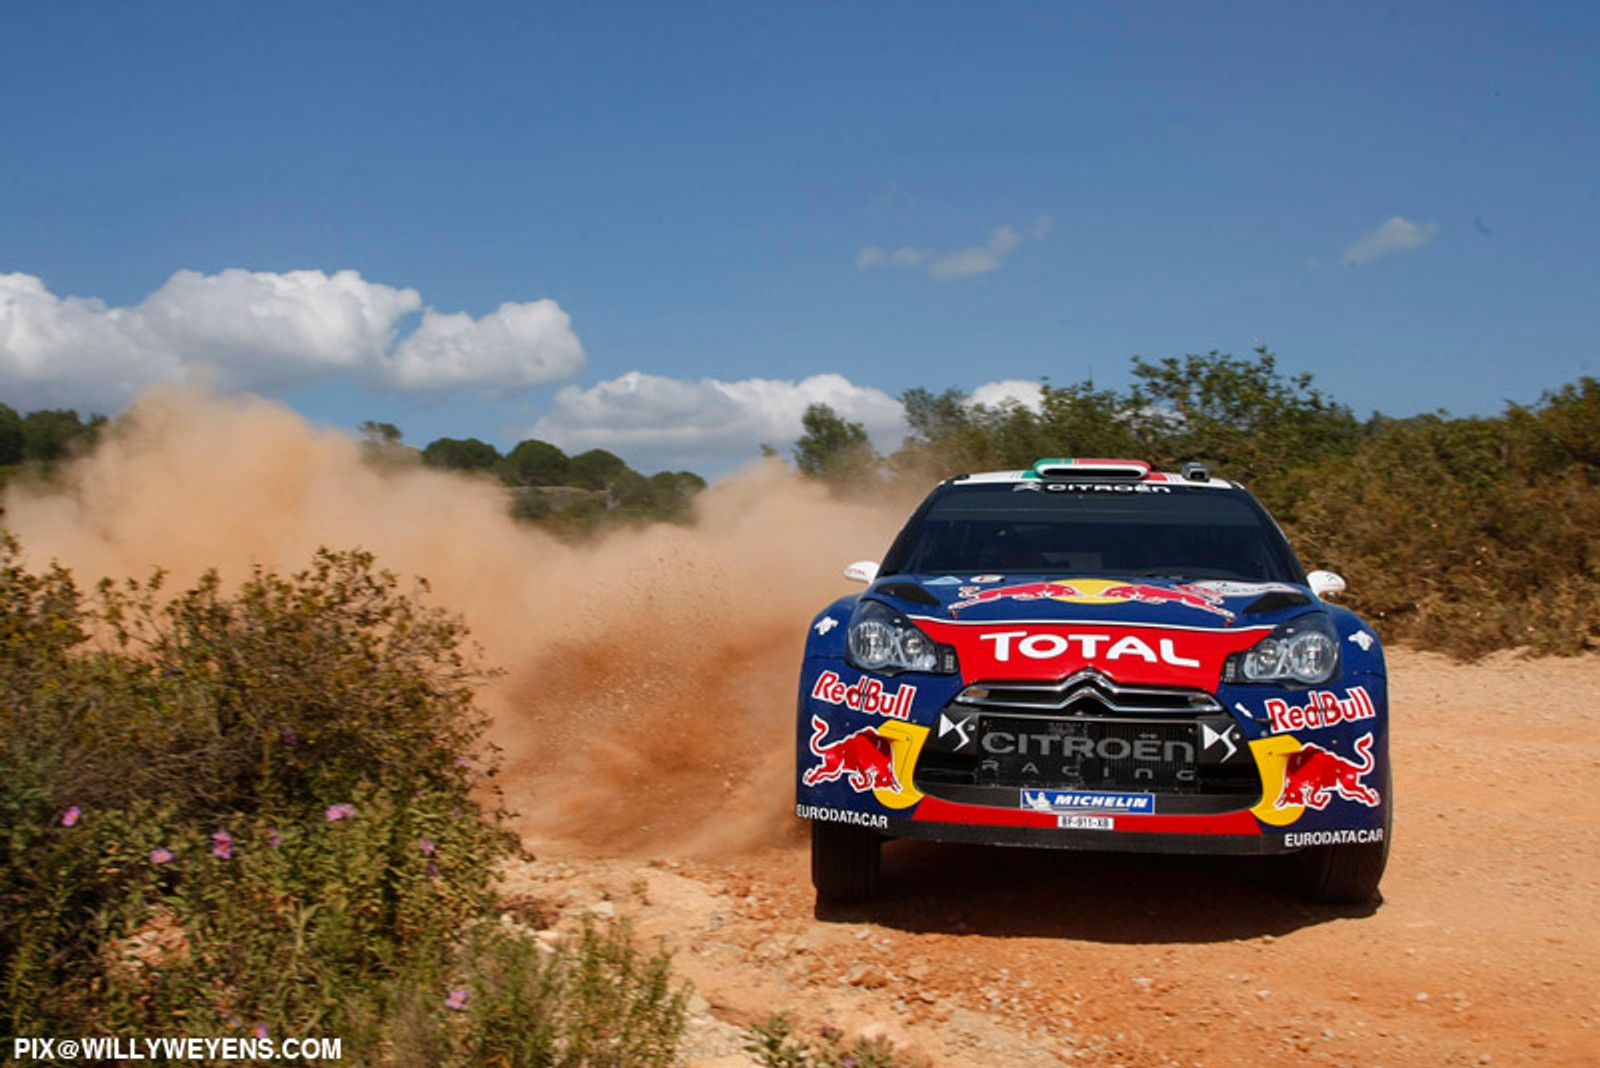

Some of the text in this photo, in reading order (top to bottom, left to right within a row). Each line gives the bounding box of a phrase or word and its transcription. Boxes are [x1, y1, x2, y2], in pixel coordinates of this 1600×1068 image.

[980, 631, 1200, 668] TOTAL
[1054, 794, 1148, 808] MICHELIN
[796, 803, 888, 829] EURODATACAR
[1284, 828, 1383, 848] EURODATACAR
